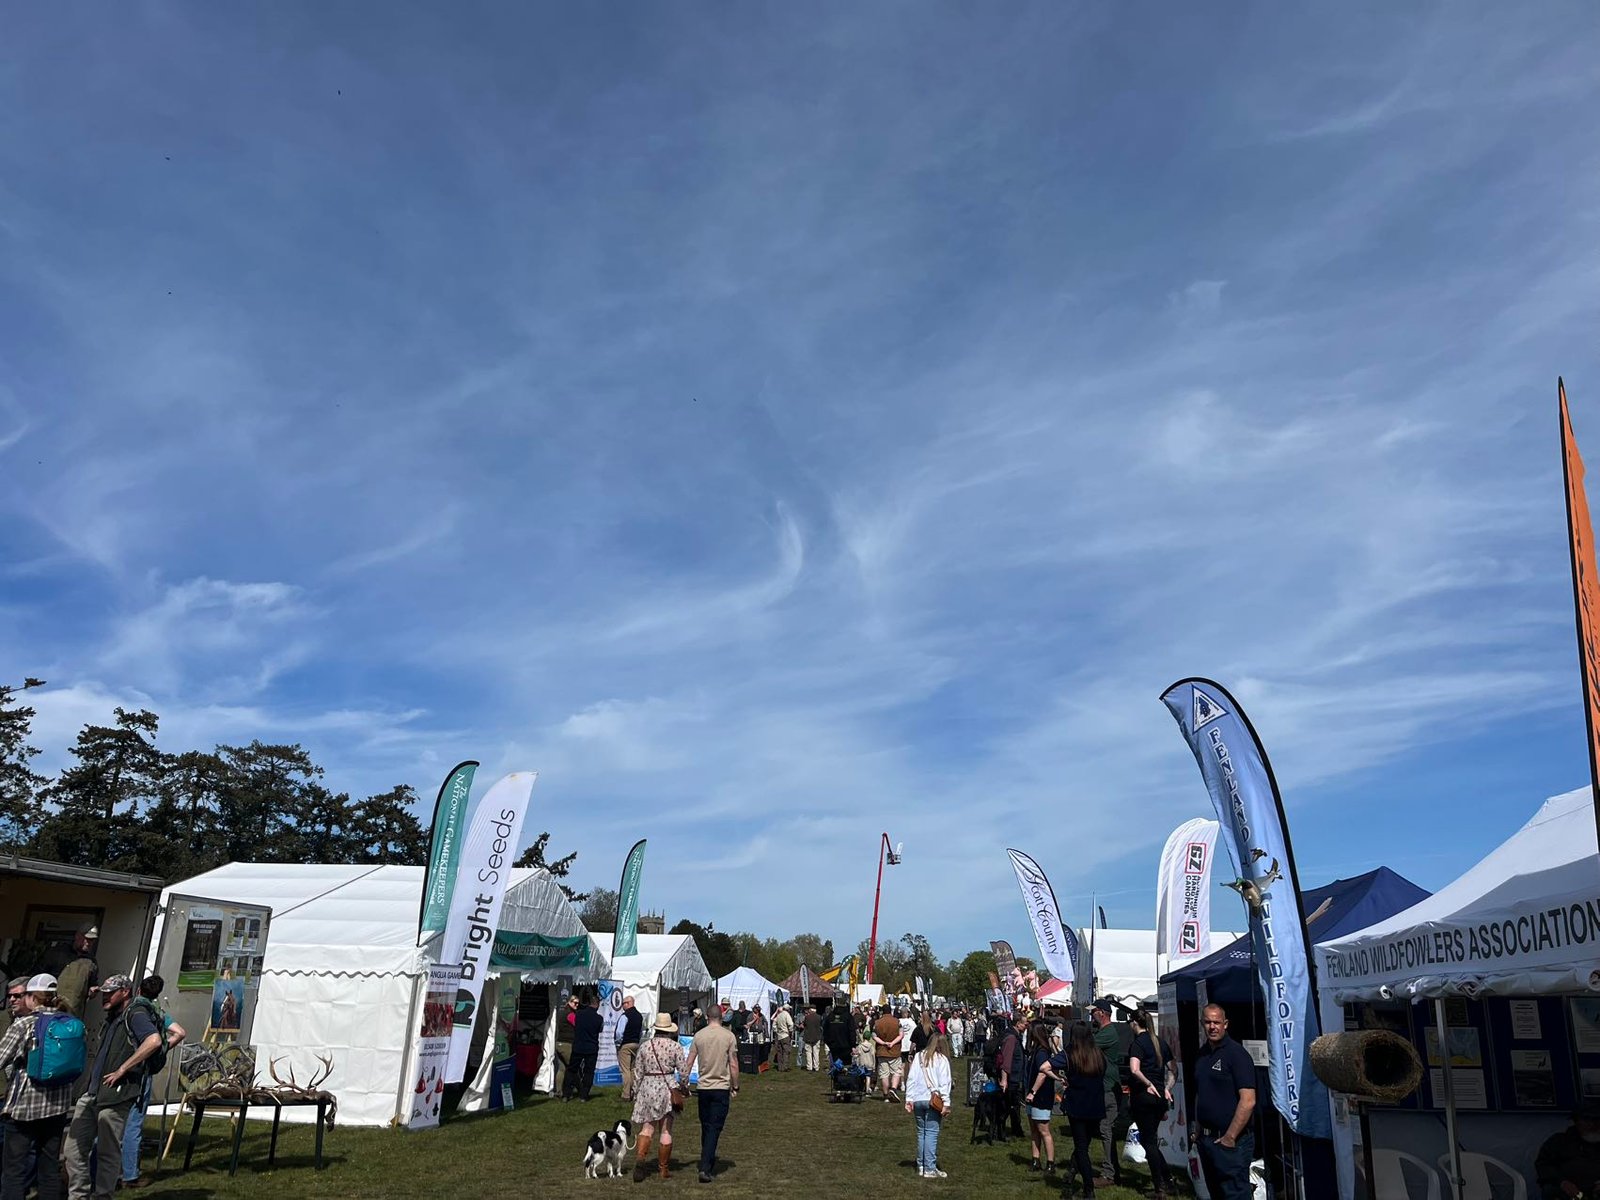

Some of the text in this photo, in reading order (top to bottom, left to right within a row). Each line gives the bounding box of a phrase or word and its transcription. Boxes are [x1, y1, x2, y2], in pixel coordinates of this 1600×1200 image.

[1209, 728, 1250, 842] FENLAND
[457, 808, 515, 980] Bright Seeds
[1189, 846, 1203, 871] GZ
[1023, 868, 1051, 906] Scott
[1037, 904, 1059, 955] Country
[1183, 924, 1196, 950] GZ
[1326, 899, 1600, 978] FENLAND WILDFOWLERS ASSOCIATION
